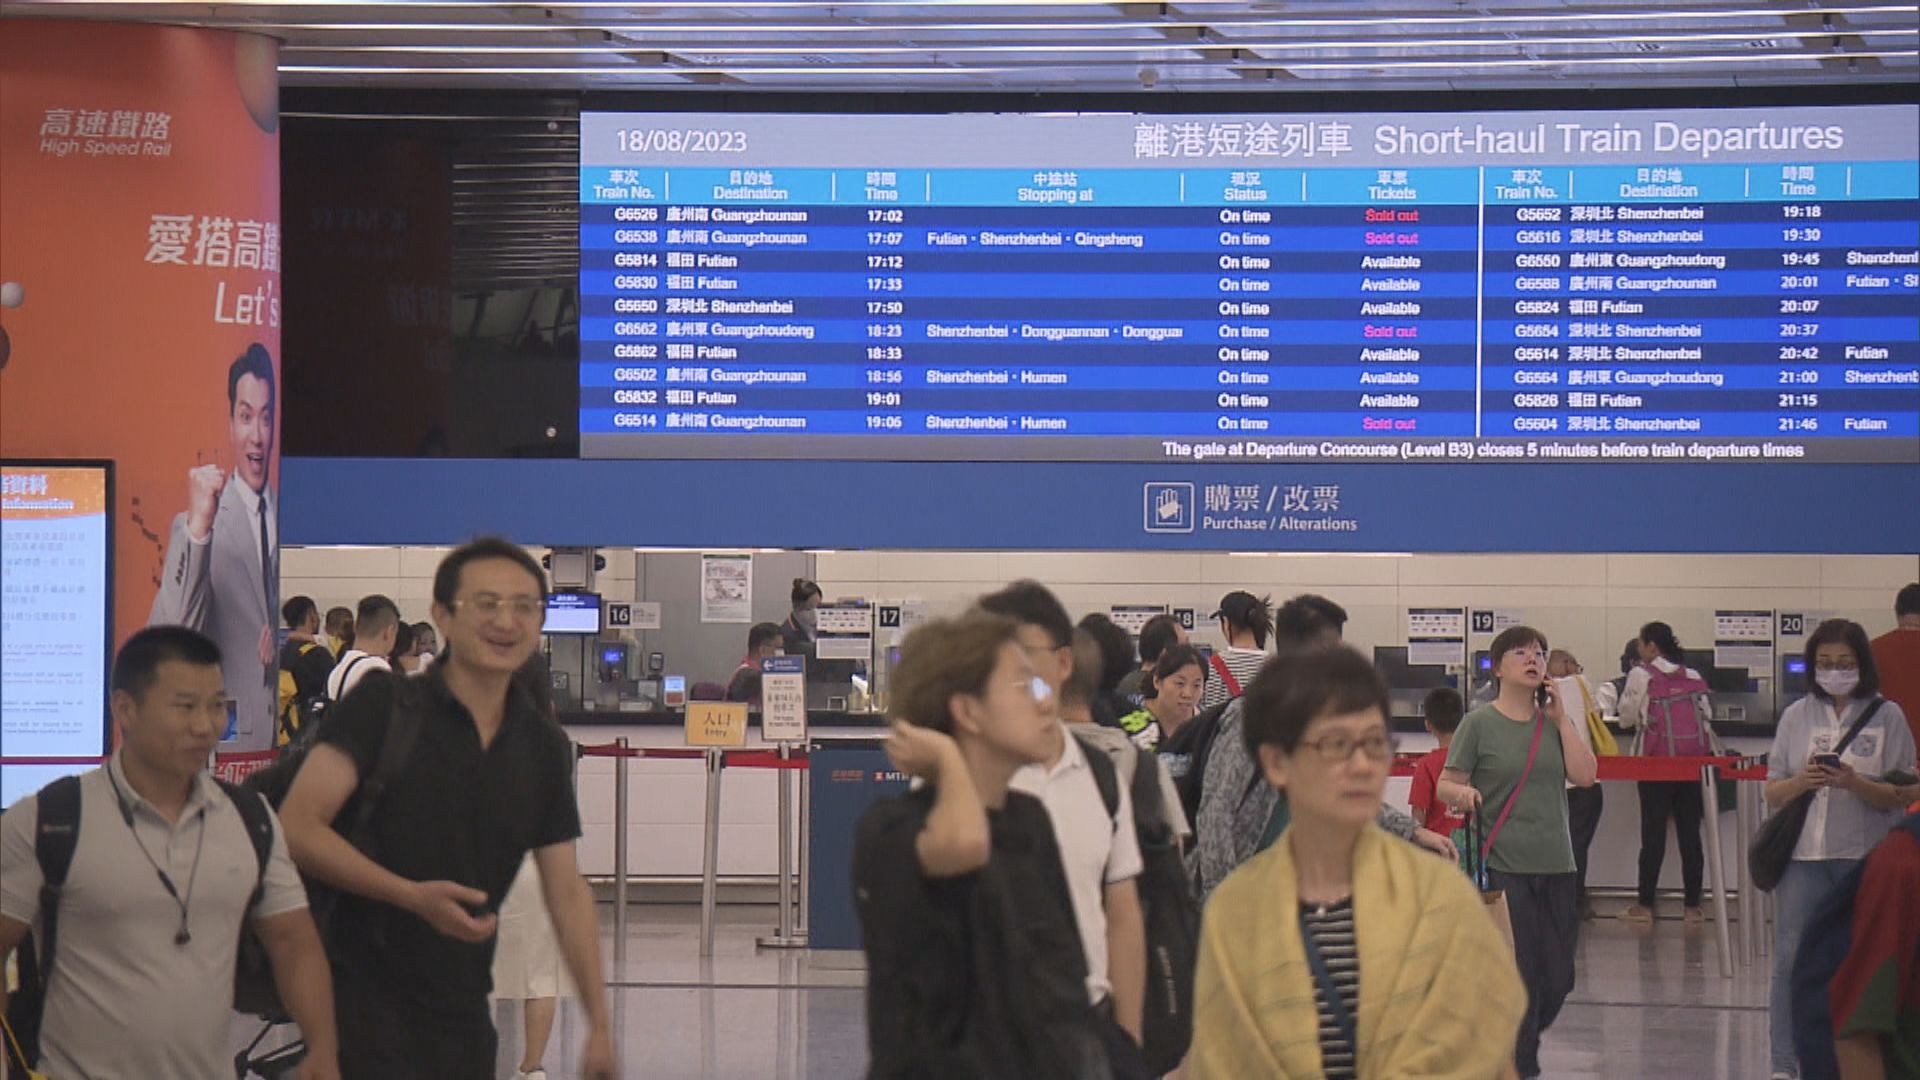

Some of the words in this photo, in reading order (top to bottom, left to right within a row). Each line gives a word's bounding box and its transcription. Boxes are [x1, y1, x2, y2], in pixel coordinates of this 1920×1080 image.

[39, 109, 172, 139] 高速鐵路
[617, 130, 747, 153] 18/08/2023
[1135, 121, 1352, 158] 離港短途列車
[1374, 124, 1545, 155] Short-haul
[1556, 123, 1641, 153] Train
[1654, 122, 1843, 158] Departures
[40, 139, 80, 157] High
[83, 140, 141, 157] Speed
[142, 141, 172, 156] Rail
[593, 186, 629, 199] Train
[631, 186, 655, 199] No.
[713, 186, 788, 200] Destination
[865, 187, 898, 201] Time
[1224, 187, 1267, 201] Status
[1369, 186, 1417, 200] Tickets
[1495, 186, 1531, 199] Train
[1534, 186, 1558, 199] No.
[1620, 184, 1698, 198] Destination
[1780, 182, 1816, 195] Time
[1018, 188, 1077, 204] Stopping
[1079, 188, 1093, 201] at
[711, 208, 808, 224] Guangzhounan
[868, 209, 903, 223] 17:02
[1219, 209, 1240, 223] On
[1242, 209, 1271, 223] time
[1365, 208, 1395, 222] Sold
[1397, 210, 1419, 222] out
[1617, 207, 1704, 221] Shenzhenbei
[1783, 206, 1822, 218] 19:18
[711, 231, 808, 247] Guangzhounan
[868, 232, 903, 245] 17:07
[927, 232, 967, 245] Futian
[980, 232, 1062, 245] Shenzhenbei
[1074, 232, 1143, 248] Qingsheng
[1219, 232, 1240, 245] On
[1242, 232, 1271, 245] time
[1617, 229, 1704, 243] Shenzhenbei
[1783, 228, 1821, 241] 19:30
[697, 254, 738, 268] Futian
[867, 255, 903, 269] 17:12
[1219, 255, 1240, 269] On
[1242, 255, 1271, 269] time
[1361, 256, 1421, 269] Available
[1616, 253, 1726, 269] Guangzhoudong
[1782, 252, 1820, 265] 19:45
[697, 276, 738, 289] Futian
[868, 278, 903, 291] 17:33
[1219, 278, 1240, 291] On
[1242, 278, 1271, 291] time
[1361, 278, 1421, 291] Available
[1616, 276, 1717, 292] Guangzhounan
[1781, 276, 1818, 288] 20:01
[1846, 275, 1890, 287] Futian
[214, 280, 280, 327] Let's
[711, 300, 794, 314] Shenzhenbei
[867, 301, 903, 314] 17:50
[1218, 301, 1239, 315] On
[1241, 301, 1270, 315] time
[1360, 302, 1421, 315] Available
[1601, 300, 1643, 314] Futian
[1780, 300, 1819, 313] 20:07
[711, 323, 815, 339] Guangzhoudong
[926, 324, 1009, 338] Shenzhenbei
[1021, 324, 1110, 341] Dongguannan
[1218, 324, 1239, 338] On
[1241, 324, 1270, 338] time
[1615, 324, 1702, 337] Shenzhenbei
[1780, 324, 1819, 336] 20:37
[697, 346, 737, 359] Futian
[867, 346, 903, 360] 18:33
[1218, 347, 1239, 361] On
[1241, 347, 1270, 361] time
[1360, 348, 1420, 361] Available
[1614, 347, 1702, 361] Shenzhenbei
[1779, 347, 1819, 360] 20:42
[1845, 346, 1889, 359] Futian
[711, 369, 807, 385] Guangzhounan
[926, 370, 1009, 384] Shenzhenbei
[1021, 370, 1067, 384] Humen
[1218, 370, 1239, 384] On
[1241, 370, 1270, 384] time
[1359, 372, 1419, 384] Available
[1615, 370, 1724, 386] Guangzhoudong
[1779, 370, 1818, 383] 21:00
[697, 391, 737, 405] Futian
[866, 392, 901, 406] 19:01
[1217, 393, 1238, 407] On
[1240, 393, 1269, 407] time
[1359, 394, 1420, 408] Available
[1600, 393, 1642, 408] Futian
[1779, 394, 1818, 407] 21:15
[711, 414, 806, 430] Guangzhounan
[926, 415, 1008, 429] Shenzhenbei
[1021, 416, 1067, 429] Humen
[1217, 416, 1238, 430] On
[1240, 416, 1269, 430] time
[1614, 417, 1701, 431] Shenzhenbei
[1779, 418, 1818, 430] 21:46
[1844, 418, 1887, 430] Futian
[1162, 442, 1191, 457] The
[1193, 442, 1227, 460] gate
[1228, 442, 1243, 457] at
[1245, 442, 1318, 460] Departure
[1320, 442, 1398, 457] Concourse
[1400, 442, 1446, 460] (Level
[1448, 442, 1475, 460] B3)
[1477, 442, 1524, 457] closes
[1526, 442, 1538, 457] 5
[1540, 442, 1599, 457] minutes
[1601, 442, 1649, 457] before
[1651, 442, 1685, 457] train
[1687, 442, 1760, 460] departure
[1762, 442, 1805, 457] times
[1203, 516, 1267, 531] Purchase
[1278, 516, 1358, 531] Alterations
[610, 607, 629, 622] 16
[881, 609, 899, 624] 17
[1175, 611, 1193, 627] 18
[1474, 614, 1493, 630] 19
[1782, 617, 1802, 632] 20
[702, 710, 731, 727] 入口
